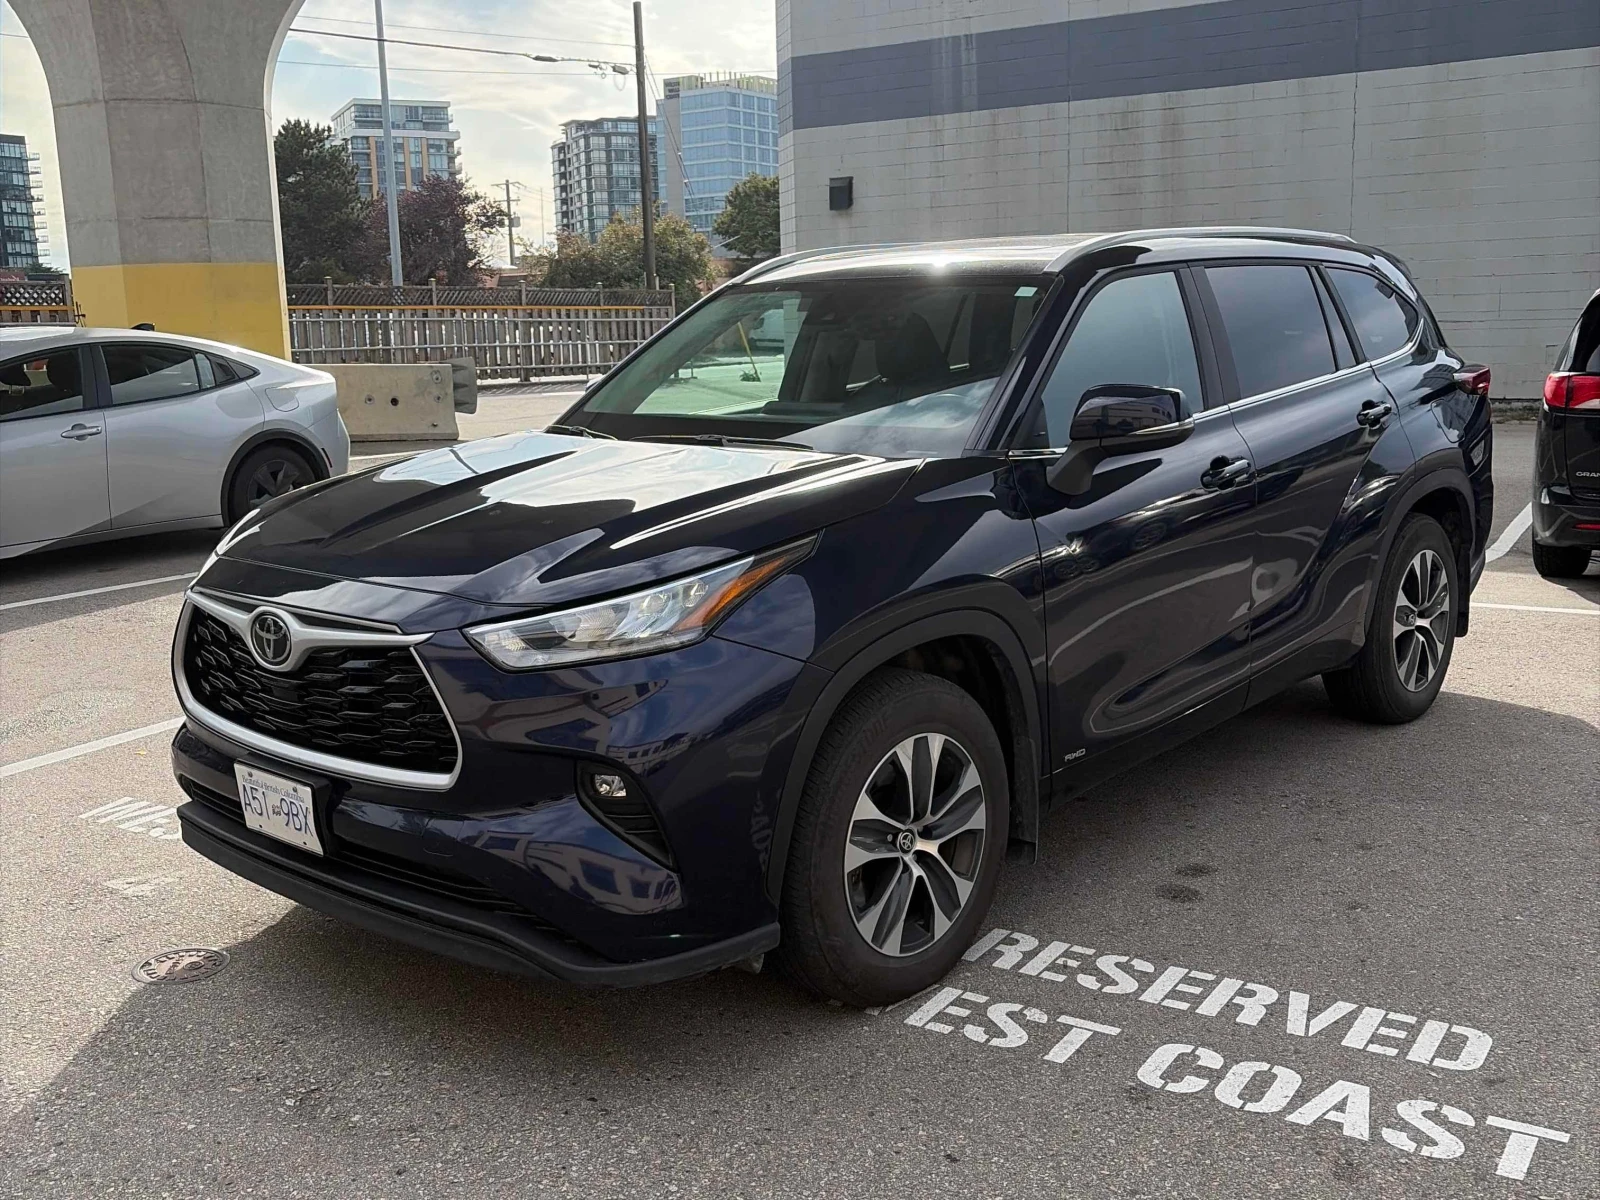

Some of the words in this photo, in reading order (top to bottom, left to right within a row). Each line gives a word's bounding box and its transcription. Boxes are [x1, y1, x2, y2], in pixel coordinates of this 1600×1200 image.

[1064, 748, 1086, 762] AWD
[243, 783, 270, 820] A51
[280, 797, 313, 837] 9BX
[961, 928, 1493, 1072] RESERVED
[1136, 1043, 1571, 1181] COAST
